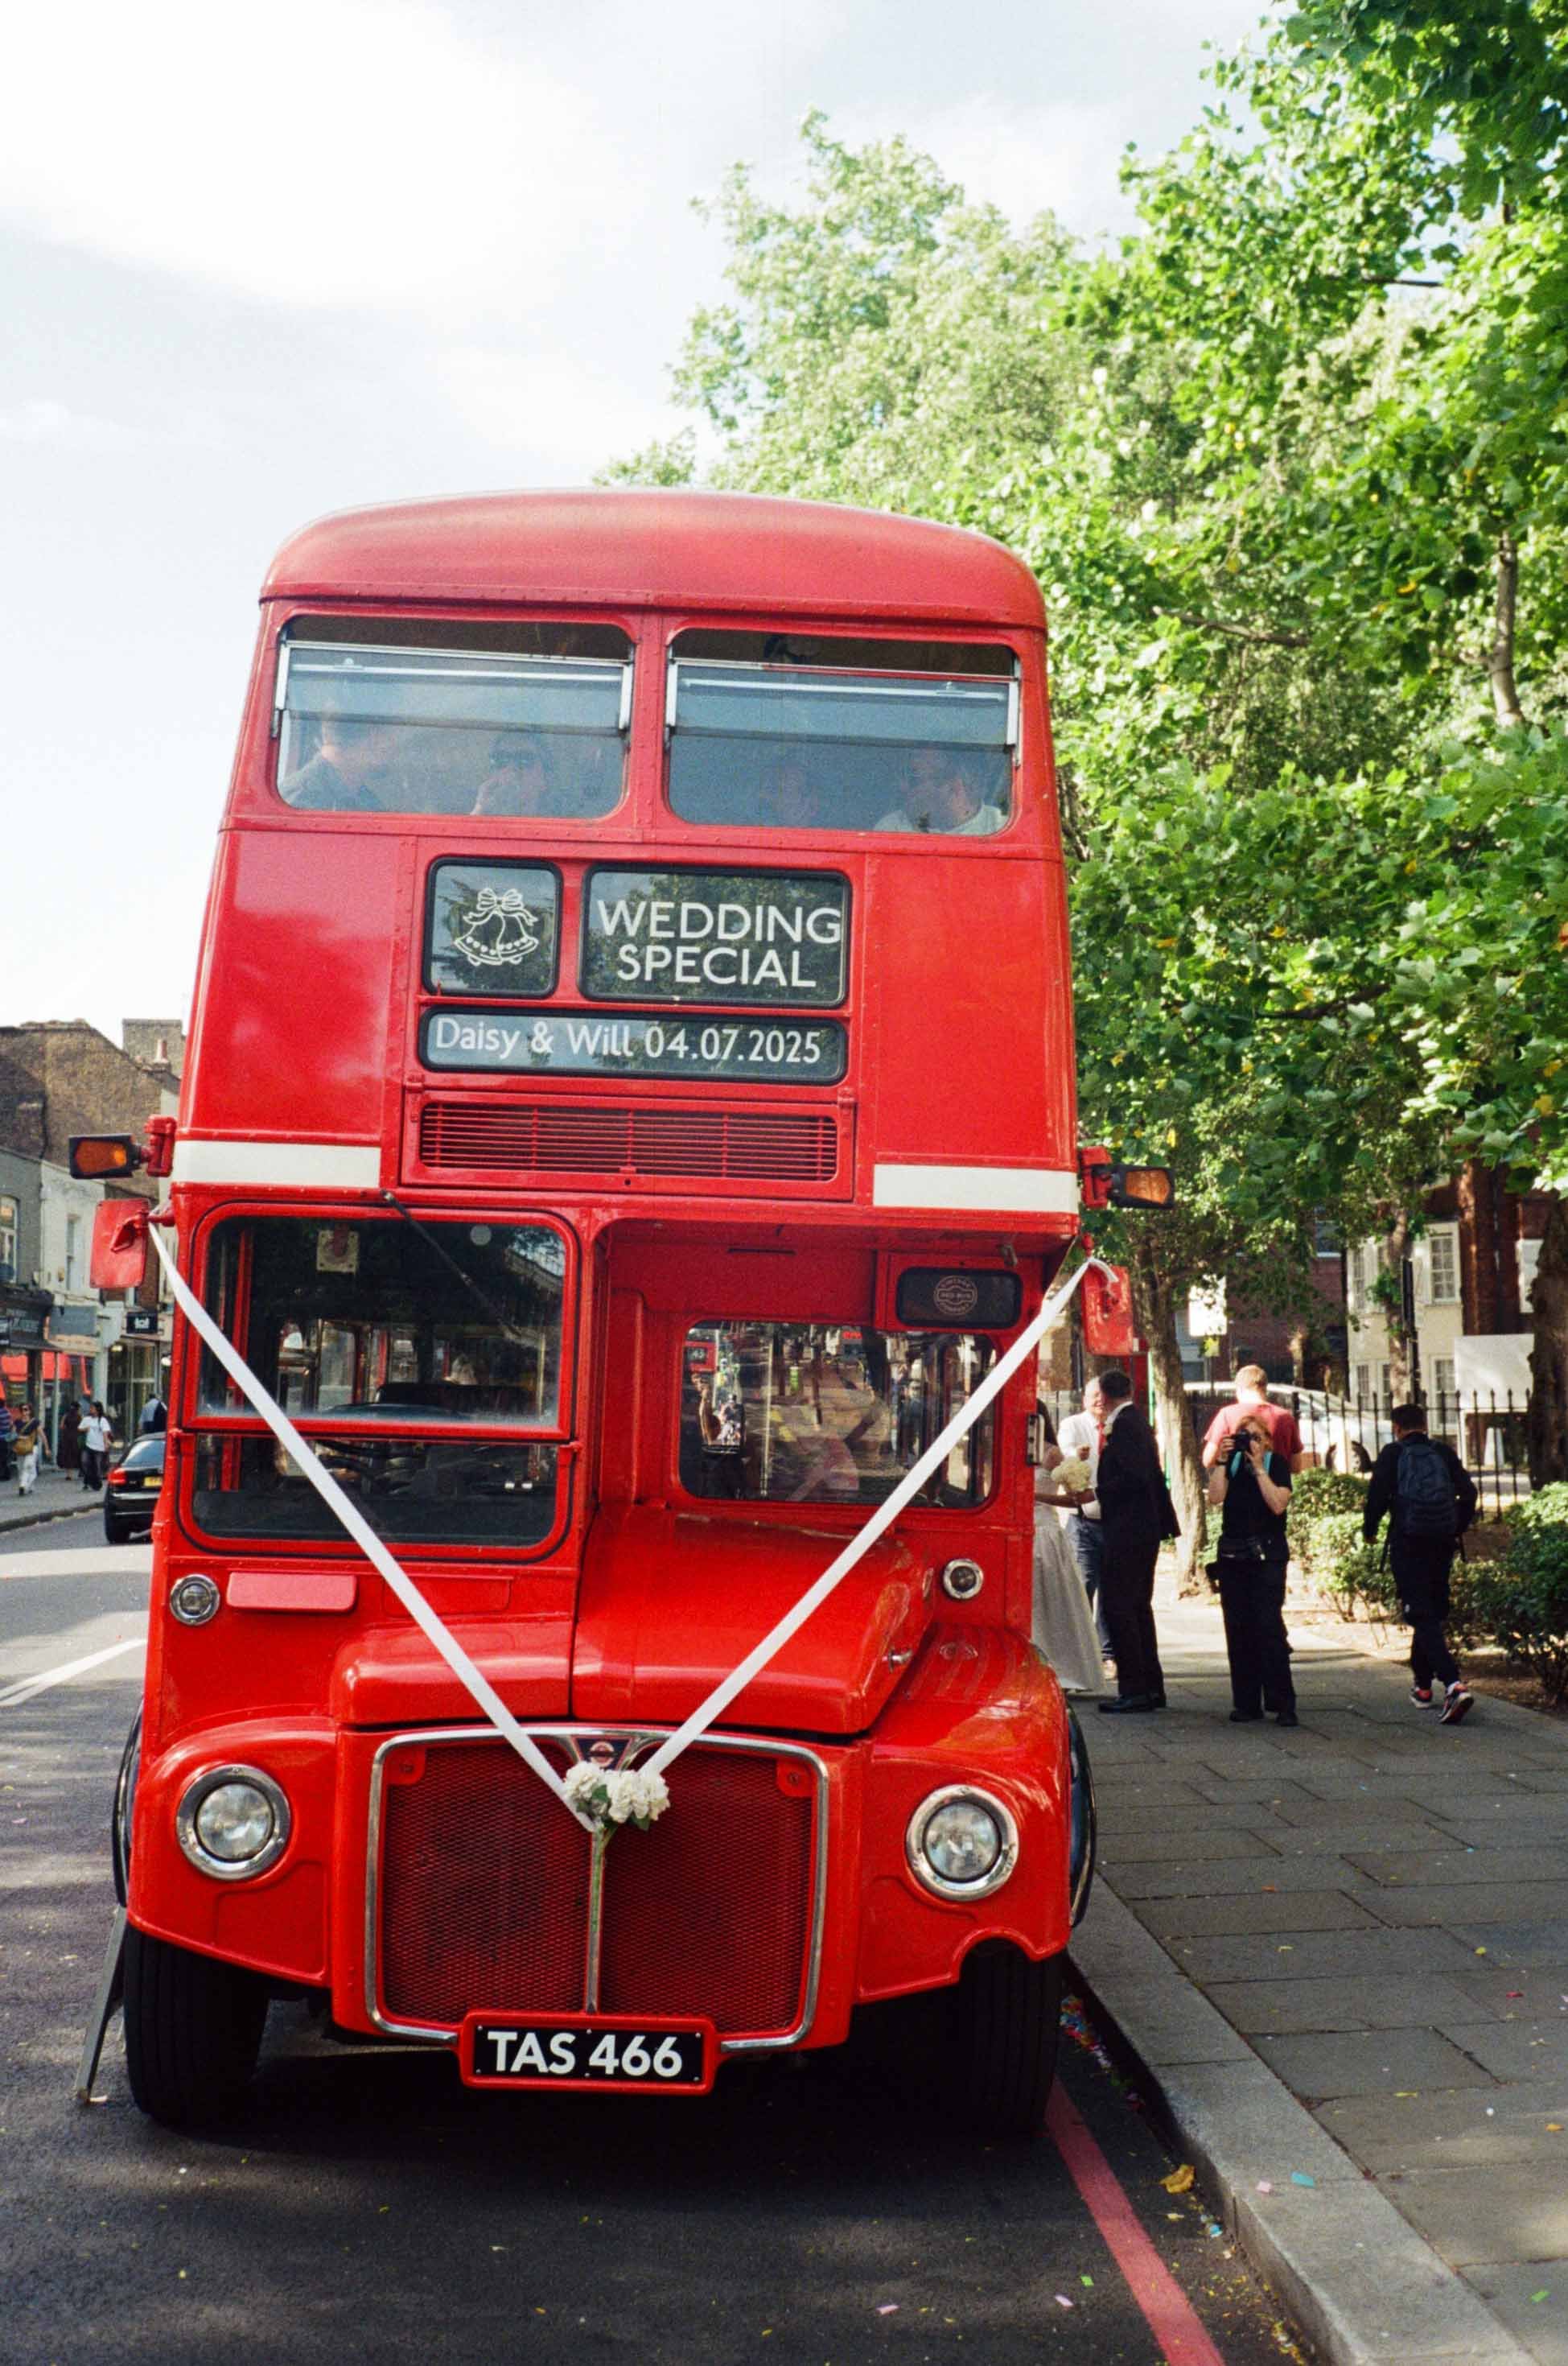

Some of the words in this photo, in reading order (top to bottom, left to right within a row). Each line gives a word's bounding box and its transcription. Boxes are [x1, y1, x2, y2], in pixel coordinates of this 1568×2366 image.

[598, 899, 842, 944] WEDDING
[617, 945, 817, 988] SPECIAL
[435, 1016, 520, 1057] Daisy
[530, 1022, 554, 1055] &
[567, 1024, 634, 1057] Will
[644, 1024, 821, 1064] 04.07.2025
[487, 2030, 577, 2075] TAS
[588, 2034, 683, 2078] 466
